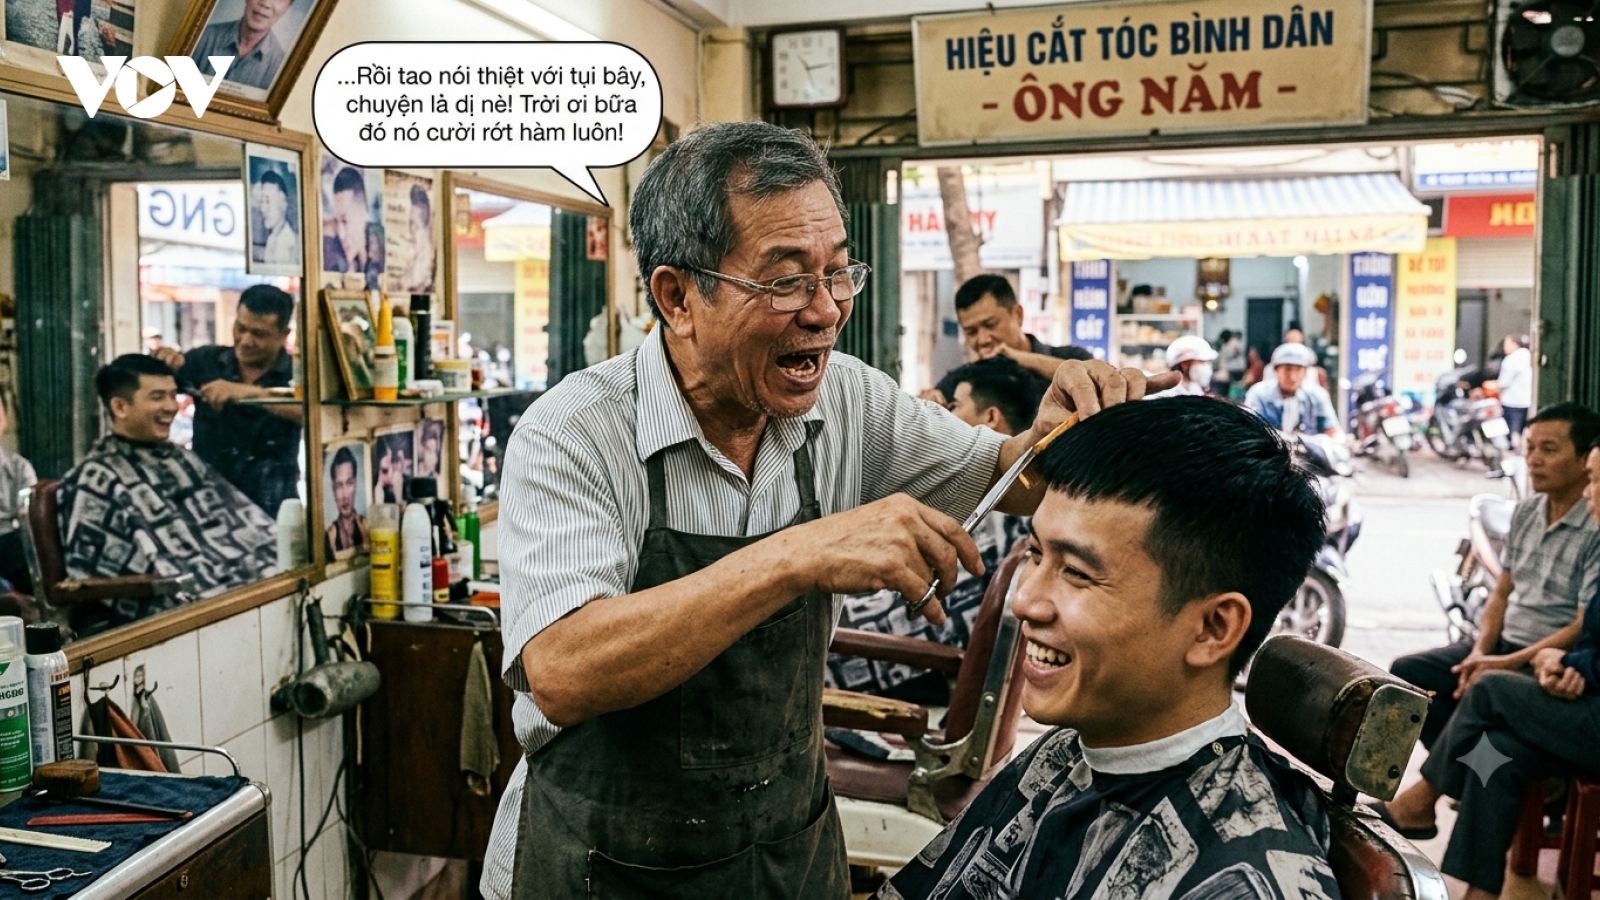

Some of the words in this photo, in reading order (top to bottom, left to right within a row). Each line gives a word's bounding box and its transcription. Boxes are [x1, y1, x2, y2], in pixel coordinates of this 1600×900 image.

[946, 28, 1016, 76] HIỆU
[1027, 15, 1087, 65] CẮT
[1096, 16, 1158, 60] TÓC
[1170, 12, 1250, 55] BÌNH
[1262, 5, 1334, 49] DÂN
[1012, 73, 1124, 122] ÔNG
[1139, 62, 1263, 116] NĂM
